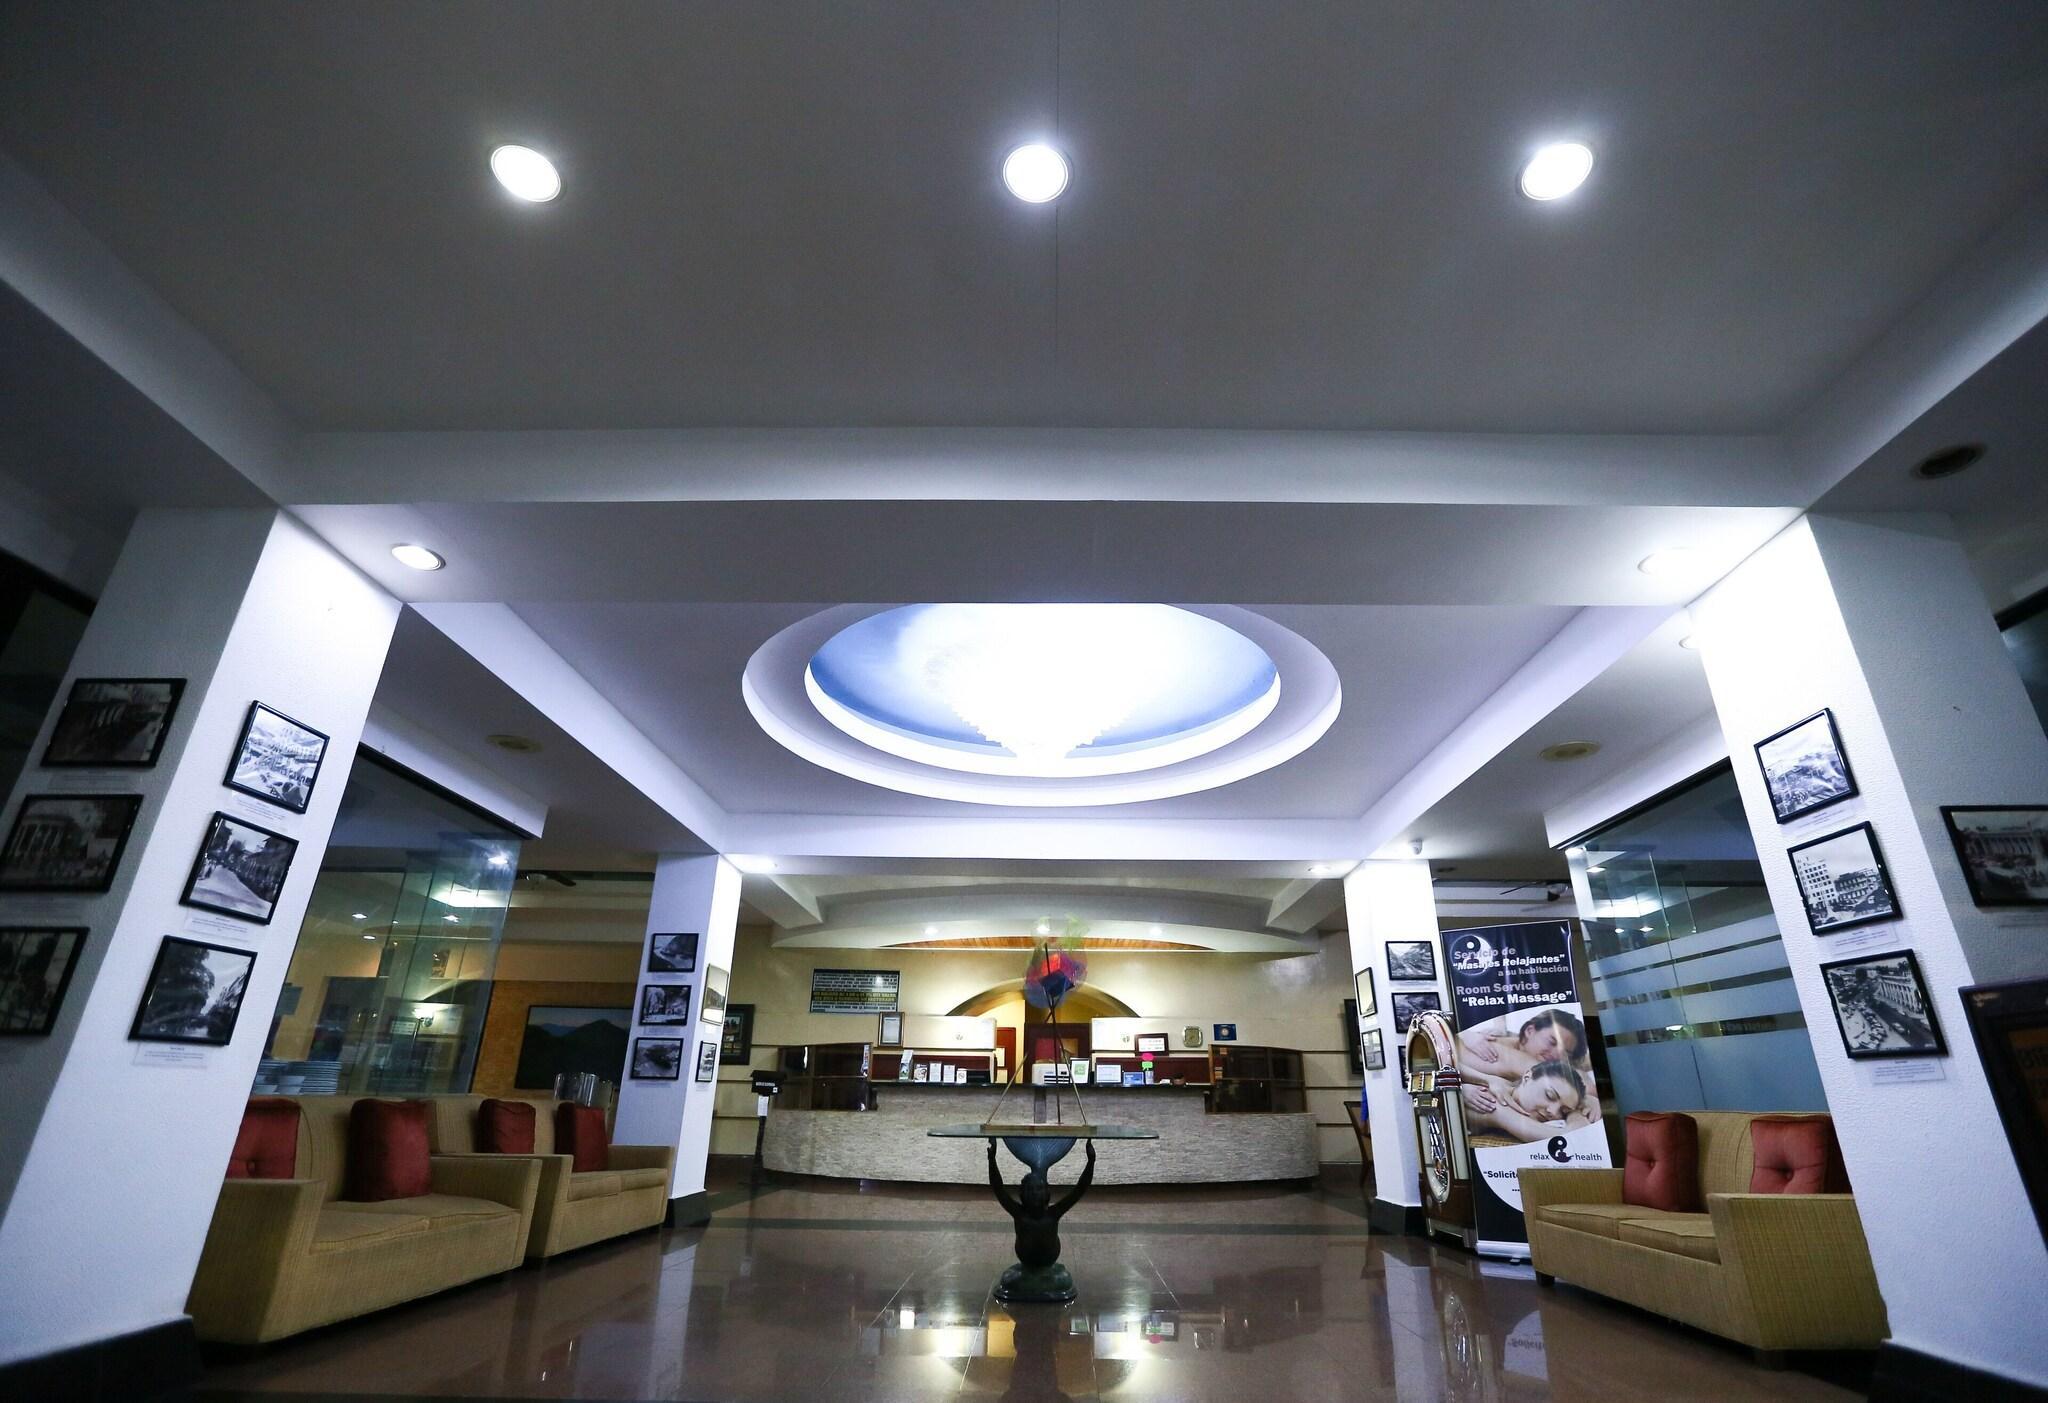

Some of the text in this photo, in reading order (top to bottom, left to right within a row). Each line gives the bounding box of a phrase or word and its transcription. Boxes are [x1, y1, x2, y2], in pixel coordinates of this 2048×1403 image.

[1454, 947, 1516, 960] Servicio de
[1518, 965, 1569, 975] habitación
[1456, 981, 1540, 995] Room Service
[1530, 1152, 1602, 1161] relax health
